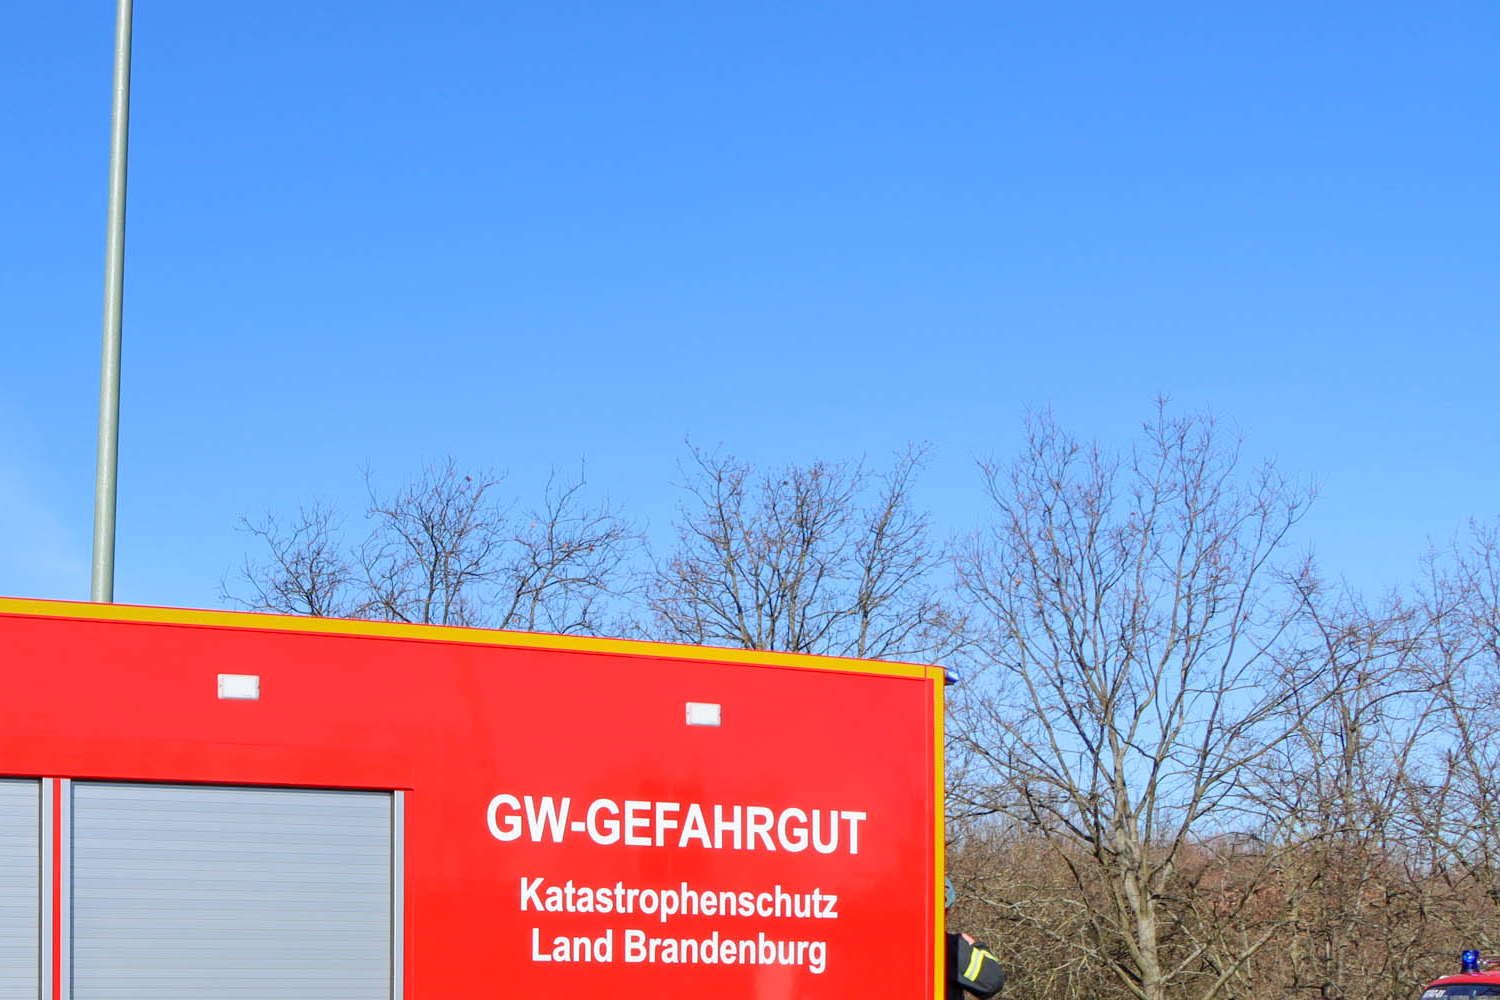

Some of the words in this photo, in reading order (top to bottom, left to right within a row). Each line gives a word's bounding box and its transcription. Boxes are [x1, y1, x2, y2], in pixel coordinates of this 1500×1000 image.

[486, 793, 867, 855] GW-GEFAHRGUT
[520, 876, 838, 923] Katastrophenschutz
[531, 927, 613, 963] Land
[624, 929, 827, 974] Brandenburg
